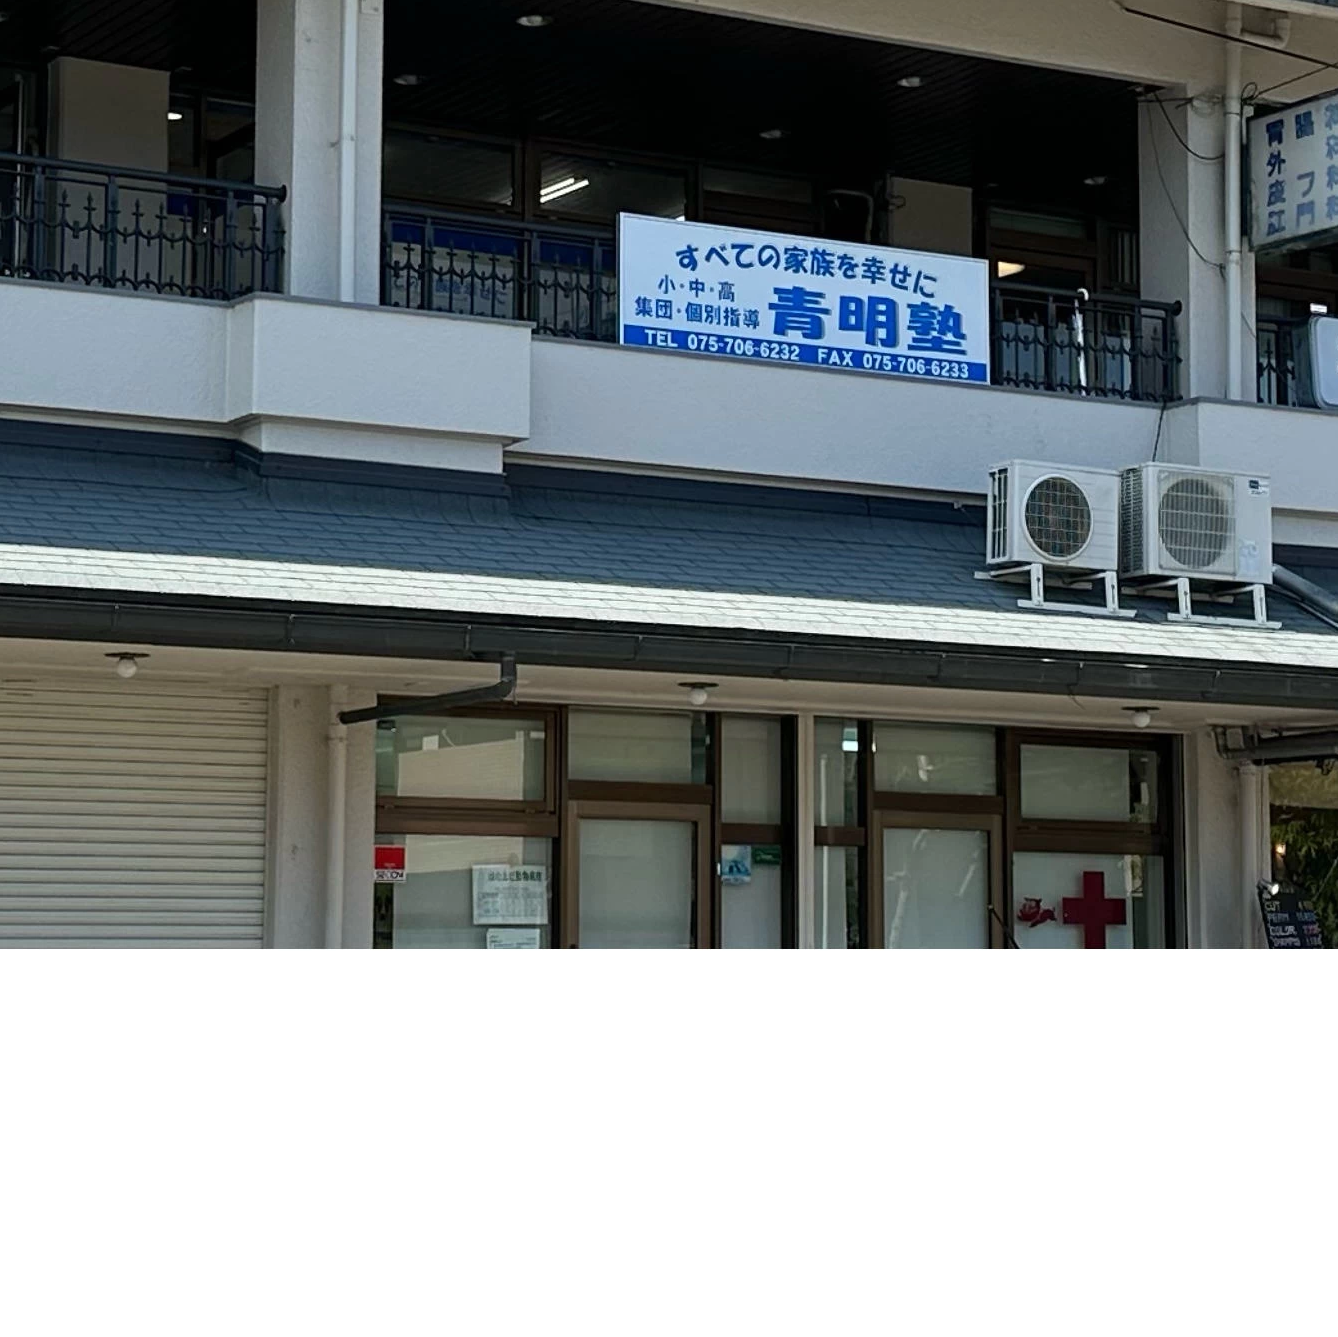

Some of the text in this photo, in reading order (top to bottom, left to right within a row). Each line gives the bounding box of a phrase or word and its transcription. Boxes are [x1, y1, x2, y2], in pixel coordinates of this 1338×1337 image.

[675, 243, 938, 299] すべての家族を幸せに
[635, 295, 761, 330] 集団・個別指導
[768, 285, 967, 356] 青明塾
[644, 329, 969, 379] TEL 075-706-6232 FAX 075-706-6233
